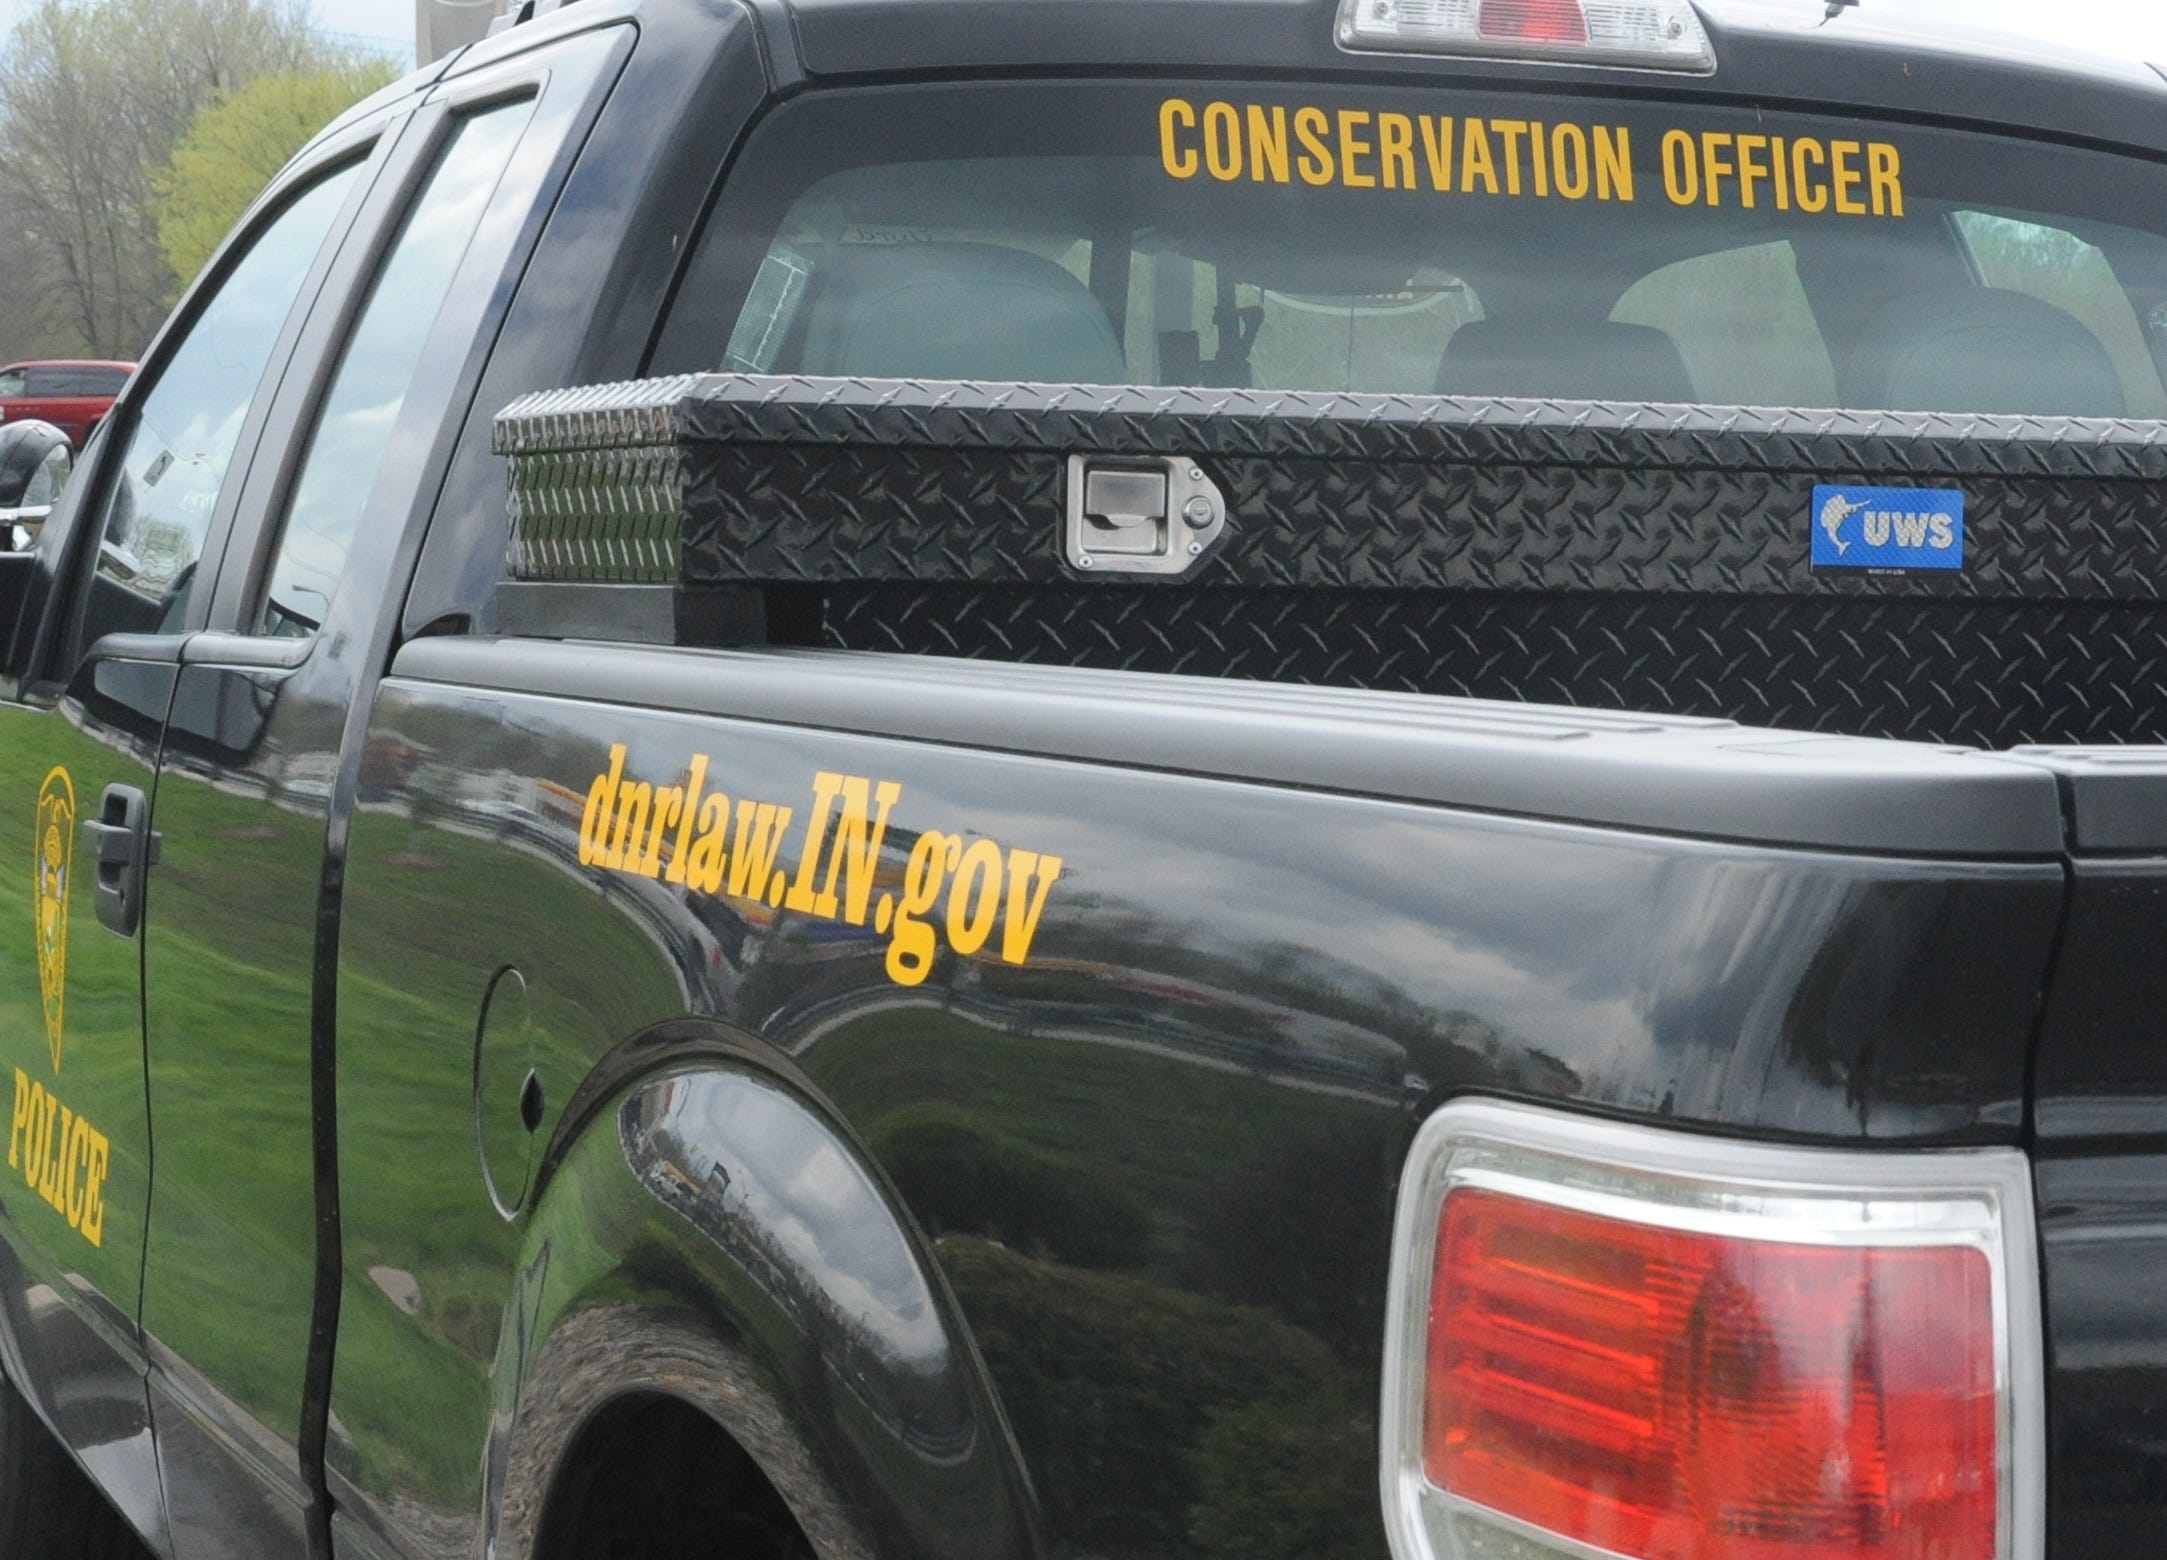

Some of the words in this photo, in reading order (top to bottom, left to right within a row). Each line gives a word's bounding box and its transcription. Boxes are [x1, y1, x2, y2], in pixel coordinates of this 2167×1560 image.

[1158, 98, 1635, 203] CONSERVATION
[1661, 129, 1905, 219] OFFICER
[1863, 510, 1954, 550] UWS
[578, 743, 1063, 987] dnrlaw.IN.gov
[8, 1067, 110, 1248] POLICE
